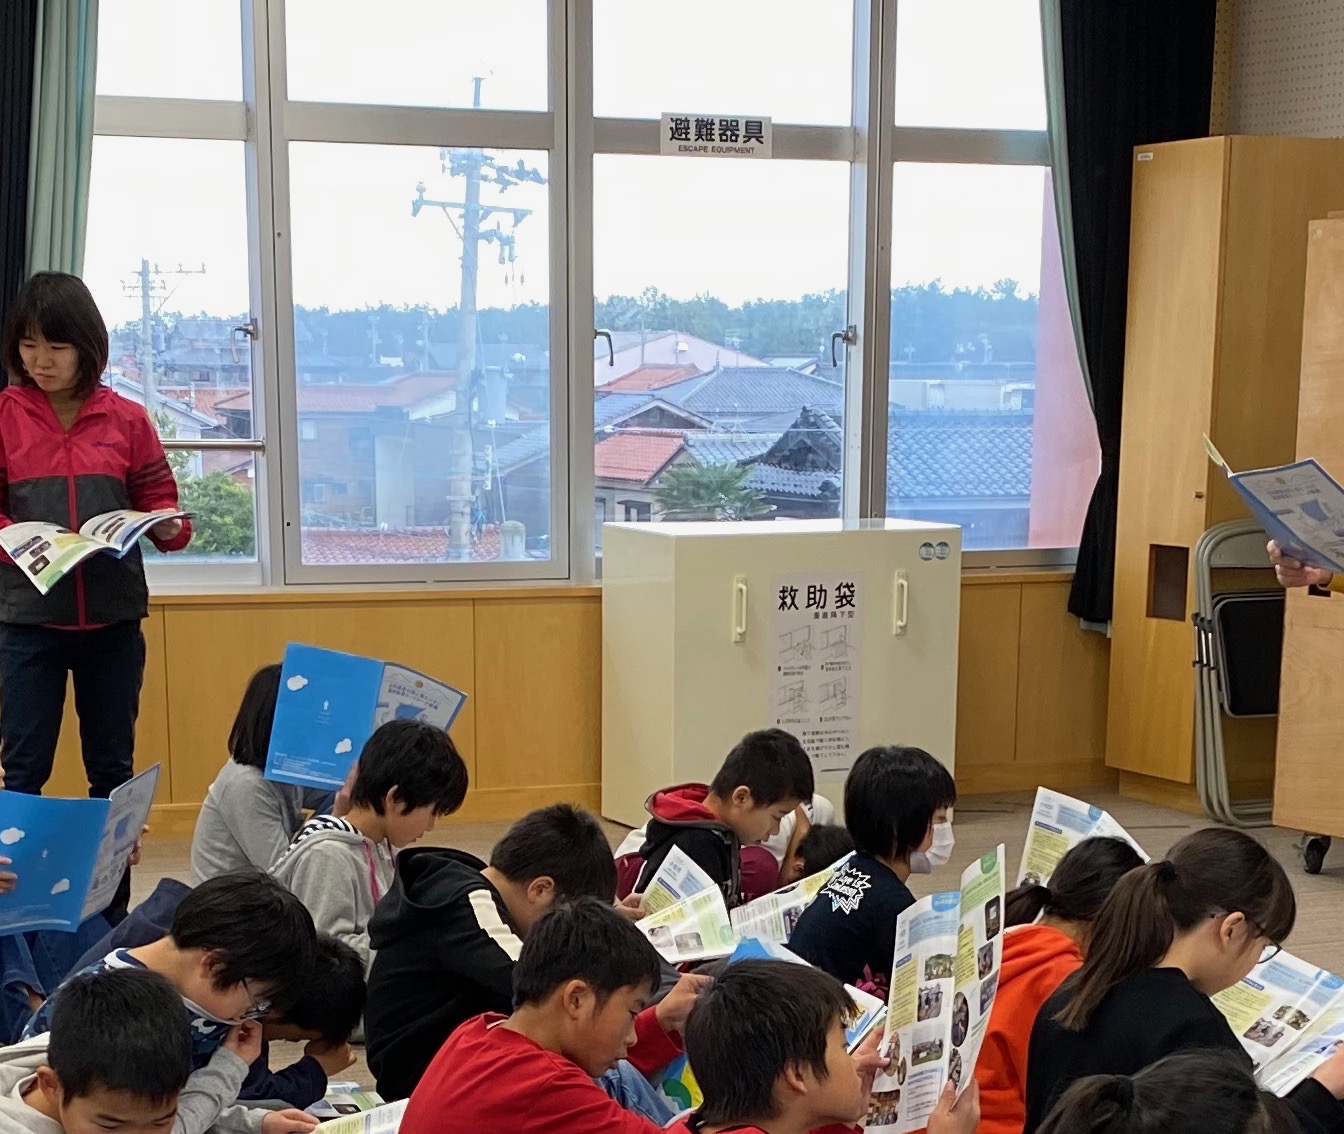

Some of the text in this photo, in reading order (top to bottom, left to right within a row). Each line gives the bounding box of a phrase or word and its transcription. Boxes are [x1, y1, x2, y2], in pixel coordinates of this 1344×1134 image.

[669, 117, 764, 145] 避難器具
[678, 144, 755, 154] ESCAPE EQUIPMENT
[778, 582, 855, 611] 救助袋
